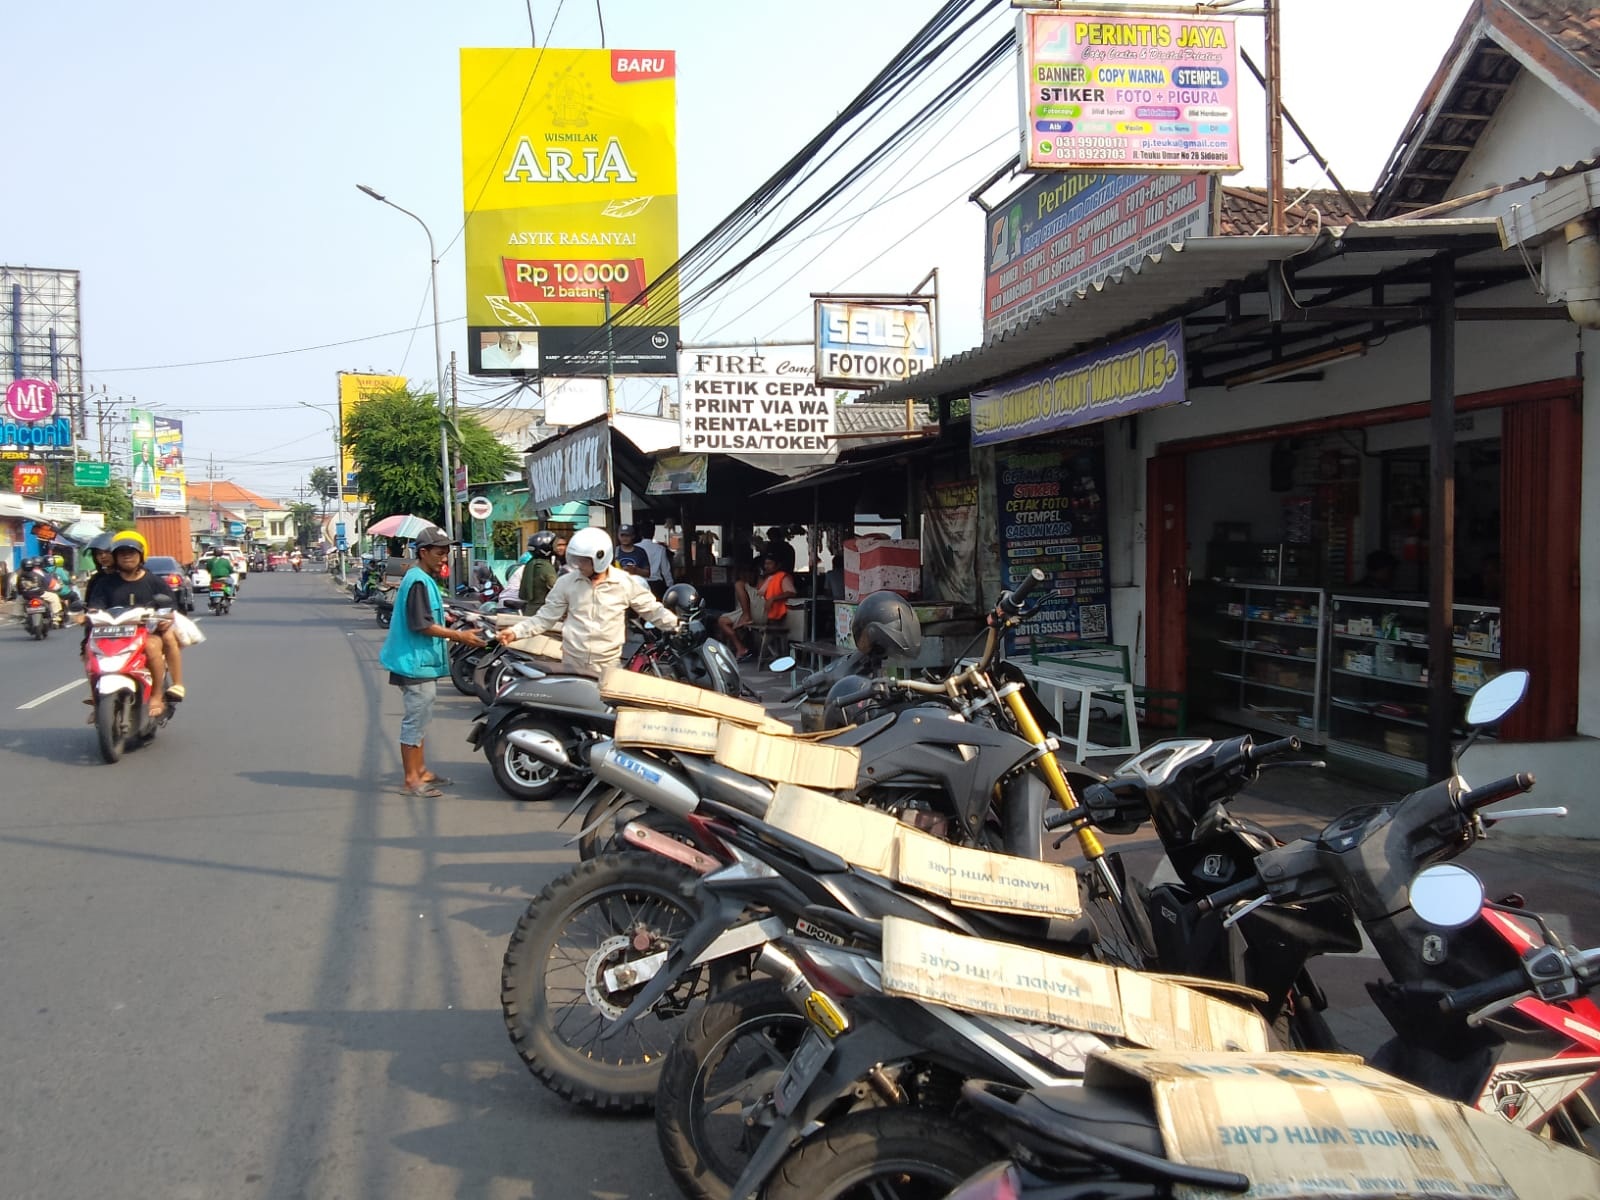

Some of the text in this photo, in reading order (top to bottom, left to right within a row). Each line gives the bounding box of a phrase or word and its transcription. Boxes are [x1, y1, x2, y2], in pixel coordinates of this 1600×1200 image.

[1075, 23, 1228, 48] PERINTIS JAYA
[1082, 47, 1106, 61] Copy
[1108, 48, 1137, 58] Center
[1140, 50, 1147, 59] &
[617, 57, 665, 73] BARU
[1038, 67, 1085, 82] BANNER
[1099, 69, 1165, 84] COPY WARNA
[1178, 71, 1223, 85] STEMPEL
[1040, 88, 1104, 102] STIKER
[1116, 90, 1151, 103] FOTO
[1168, 91, 1219, 104] PIGURA
[545, 133, 598, 142] WISMILAK
[1056, 137, 1128, 148] 031 99700171
[504, 137, 637, 183] ARJA
[1057, 148, 1126, 160] 031 8923703
[1140, 151, 1160, 159] Teuku
[1200, 152, 1228, 160] Sidoarjo
[1144, 201, 1164, 228] JILID
[1167, 181, 1197, 216] SPIRAL
[1077, 203, 1120, 243] COPYWARNA
[508, 232, 636, 246] ASYIK RASANYA!
[516, 263, 629, 287] Rp 10.000
[542, 285, 607, 300] 12 batang
[828, 311, 926, 348] SELEX
[695, 354, 769, 374] FIRE
[829, 354, 924, 375] FOTOKOPI
[1053, 370, 1090, 413] PRINT
[1090, 353, 1142, 401] WARNA
[1143, 345, 1178, 391] A3+
[694, 380, 827, 396] KETIK CEPAT
[17, 384, 47, 413] MIE
[694, 399, 829, 414] PRINT VIA WA
[0, 418, 71, 446] ACOAN
[694, 418, 829, 433] RENTAL+EDIT
[694, 435, 829, 450] PULSA/TOKEN
[2, 452, 28, 460] PEDAS
[23, 474, 38, 485] 24
[1013, 483, 1061, 499] STIKER
[1006, 497, 1069, 512] CETAK FOTO
[1015, 510, 1062, 524] STEMPEL
[1005, 524, 1044, 538] SABLON
[928, 861, 1049, 892] HANDLE WITH CARE
[919, 953, 1079, 998] HANDLE ITH CARE
[1220, 1127, 1439, 1152] HANDLE WITH CARE
